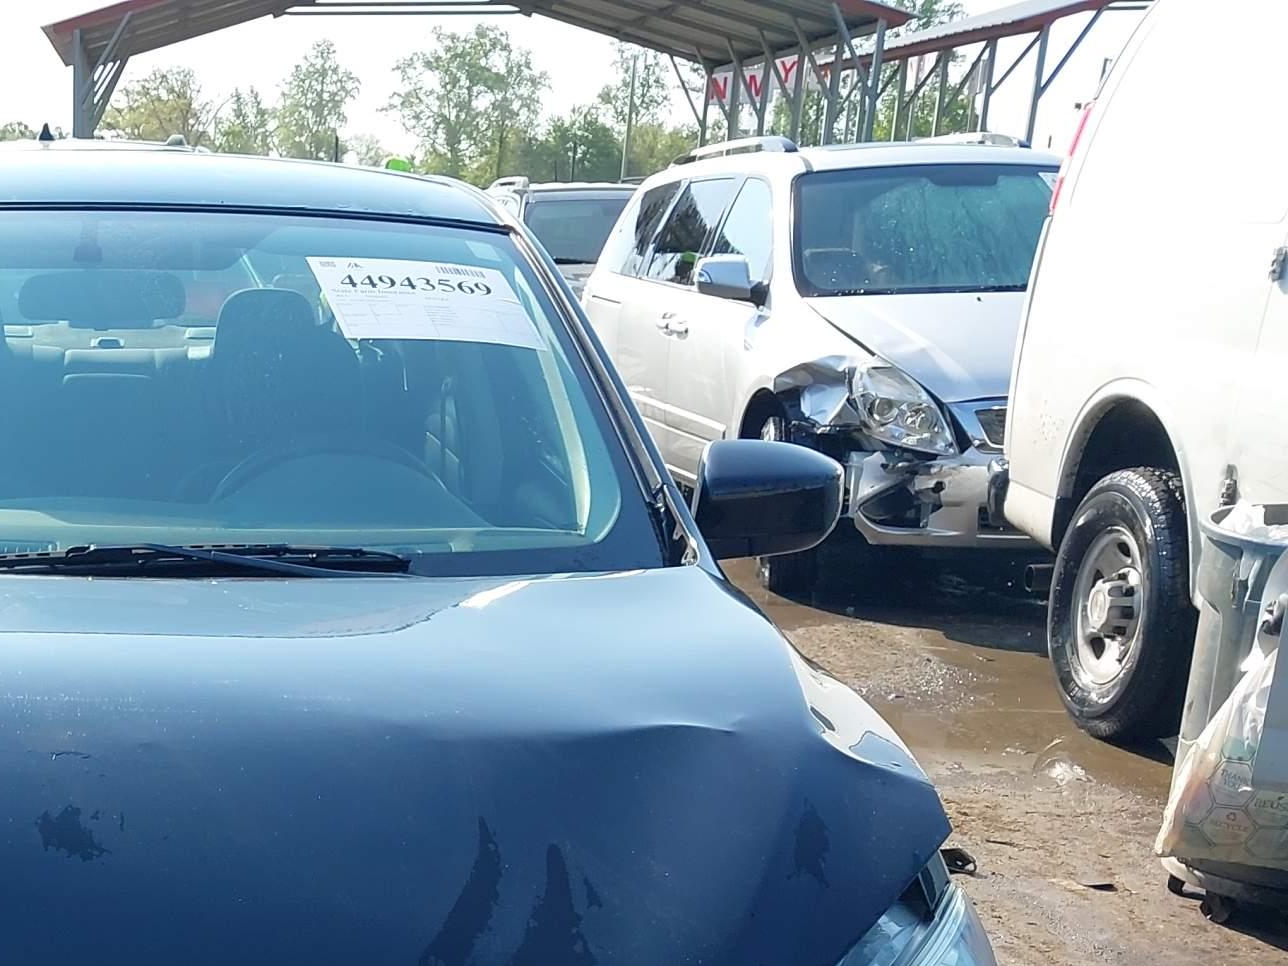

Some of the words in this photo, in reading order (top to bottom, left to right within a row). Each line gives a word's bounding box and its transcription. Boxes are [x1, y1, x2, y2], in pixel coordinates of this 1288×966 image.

[781, 60, 799, 83] Y
[711, 76, 728, 99] N
[340, 274, 492, 295] 44943569
